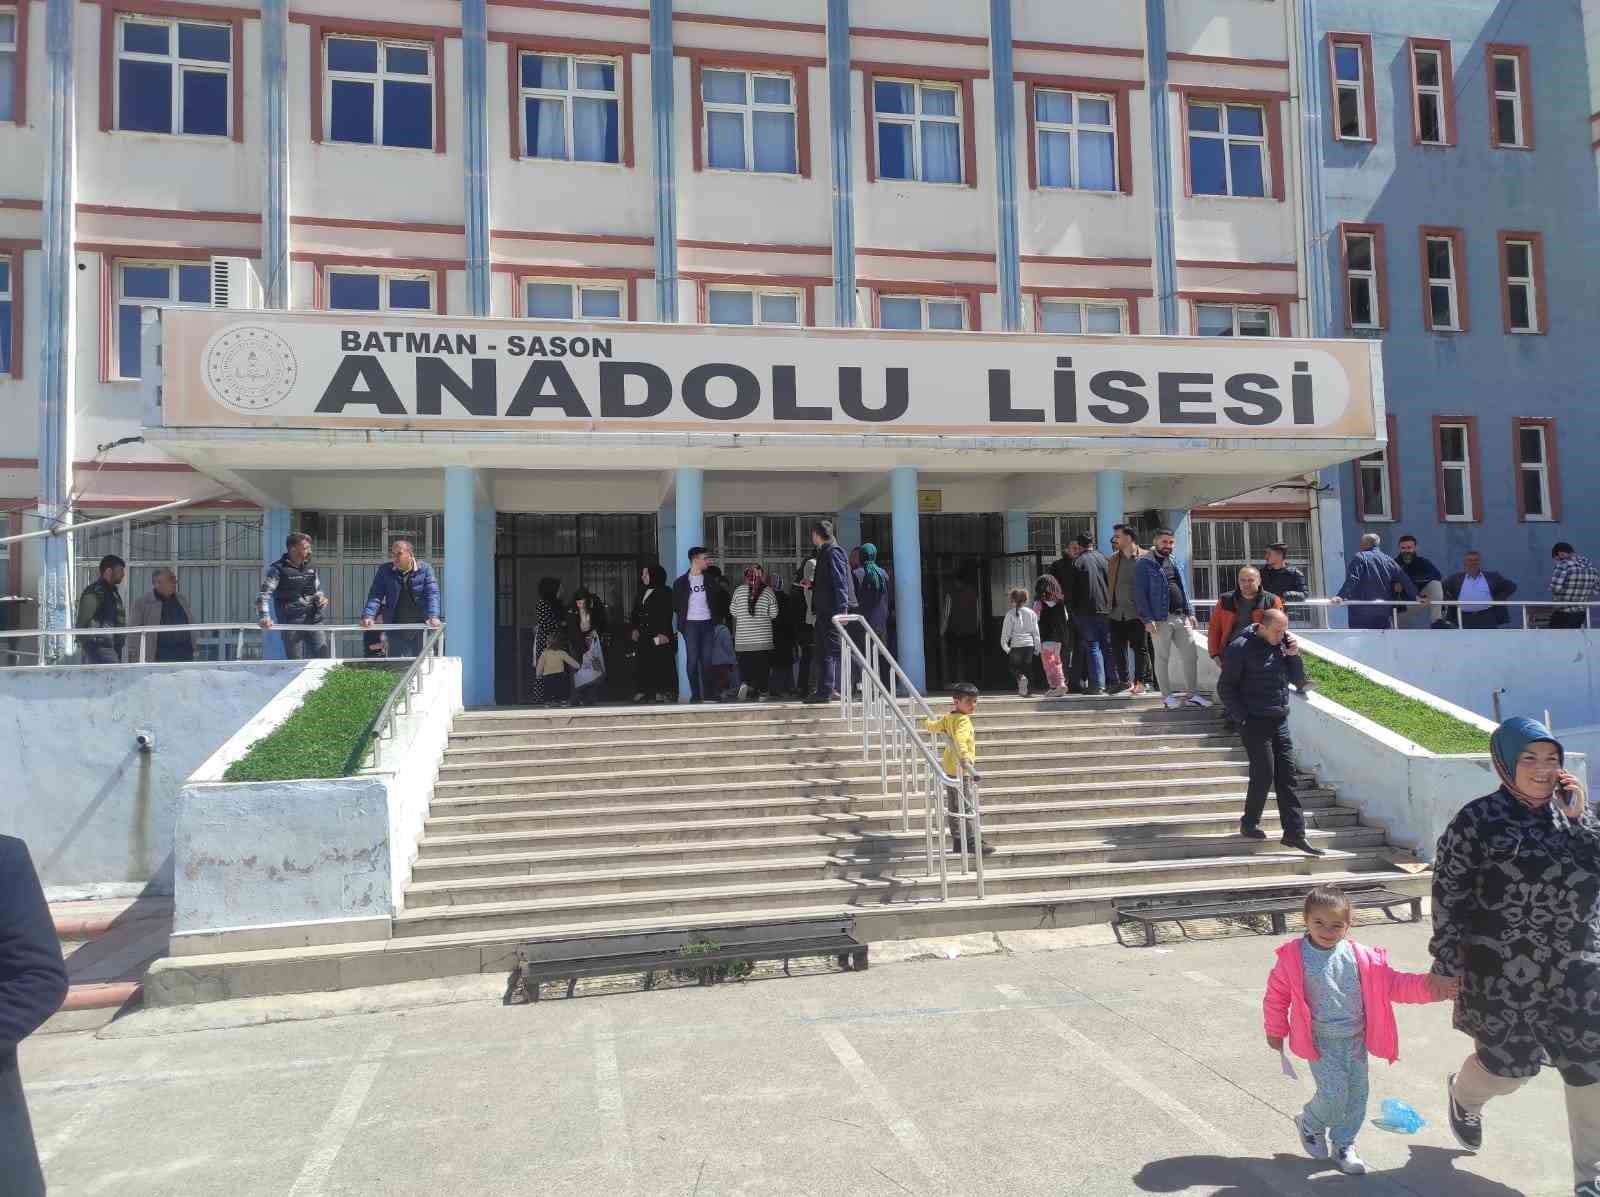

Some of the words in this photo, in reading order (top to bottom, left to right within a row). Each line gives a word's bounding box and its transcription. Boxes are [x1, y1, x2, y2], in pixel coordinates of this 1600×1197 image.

[341, 331, 476, 355] BATMAN
[507, 335, 613, 358] SASON
[313, 354, 909, 423] ANADOLU
[988, 357, 1315, 426] LİSESİ
